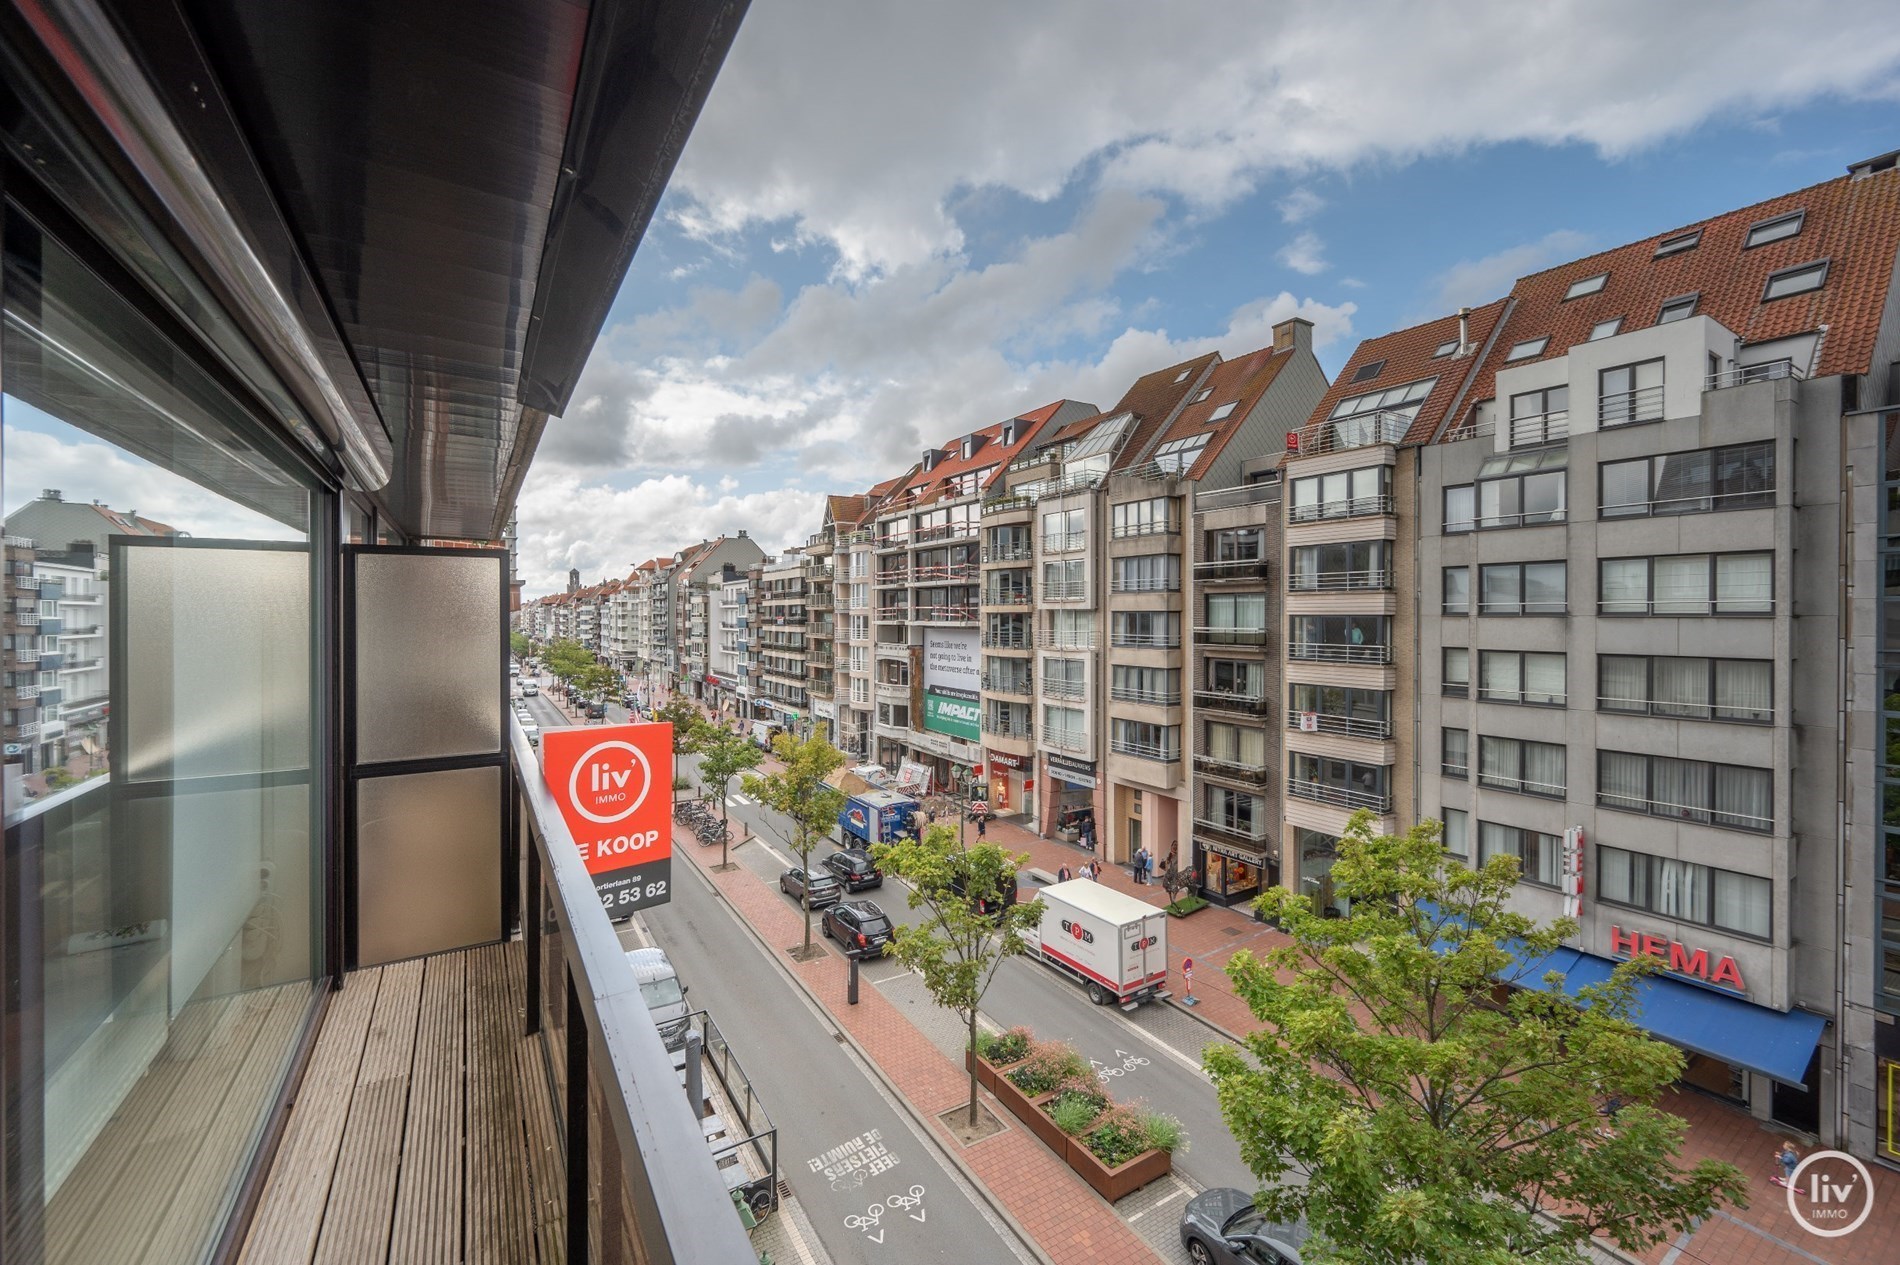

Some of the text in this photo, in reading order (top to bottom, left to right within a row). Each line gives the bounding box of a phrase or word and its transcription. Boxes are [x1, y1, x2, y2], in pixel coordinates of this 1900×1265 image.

[930, 640, 944, 648] Seems
[944, 641, 953, 649] like
[938, 653, 950, 662] going
[938, 701, 981, 721] IMPACT
[990, 753, 1018, 767] DAMART
[596, 793, 626, 805] IMMO
[576, 830, 659, 860] E KOOP
[596, 875, 642, 891] ortierlaan 89
[600, 881, 667, 908] 2 53 62
[1611, 925, 1746, 991] HEMA
[863, 1128, 883, 1144] DE
[824, 1142, 888, 1180] FIETSERS
